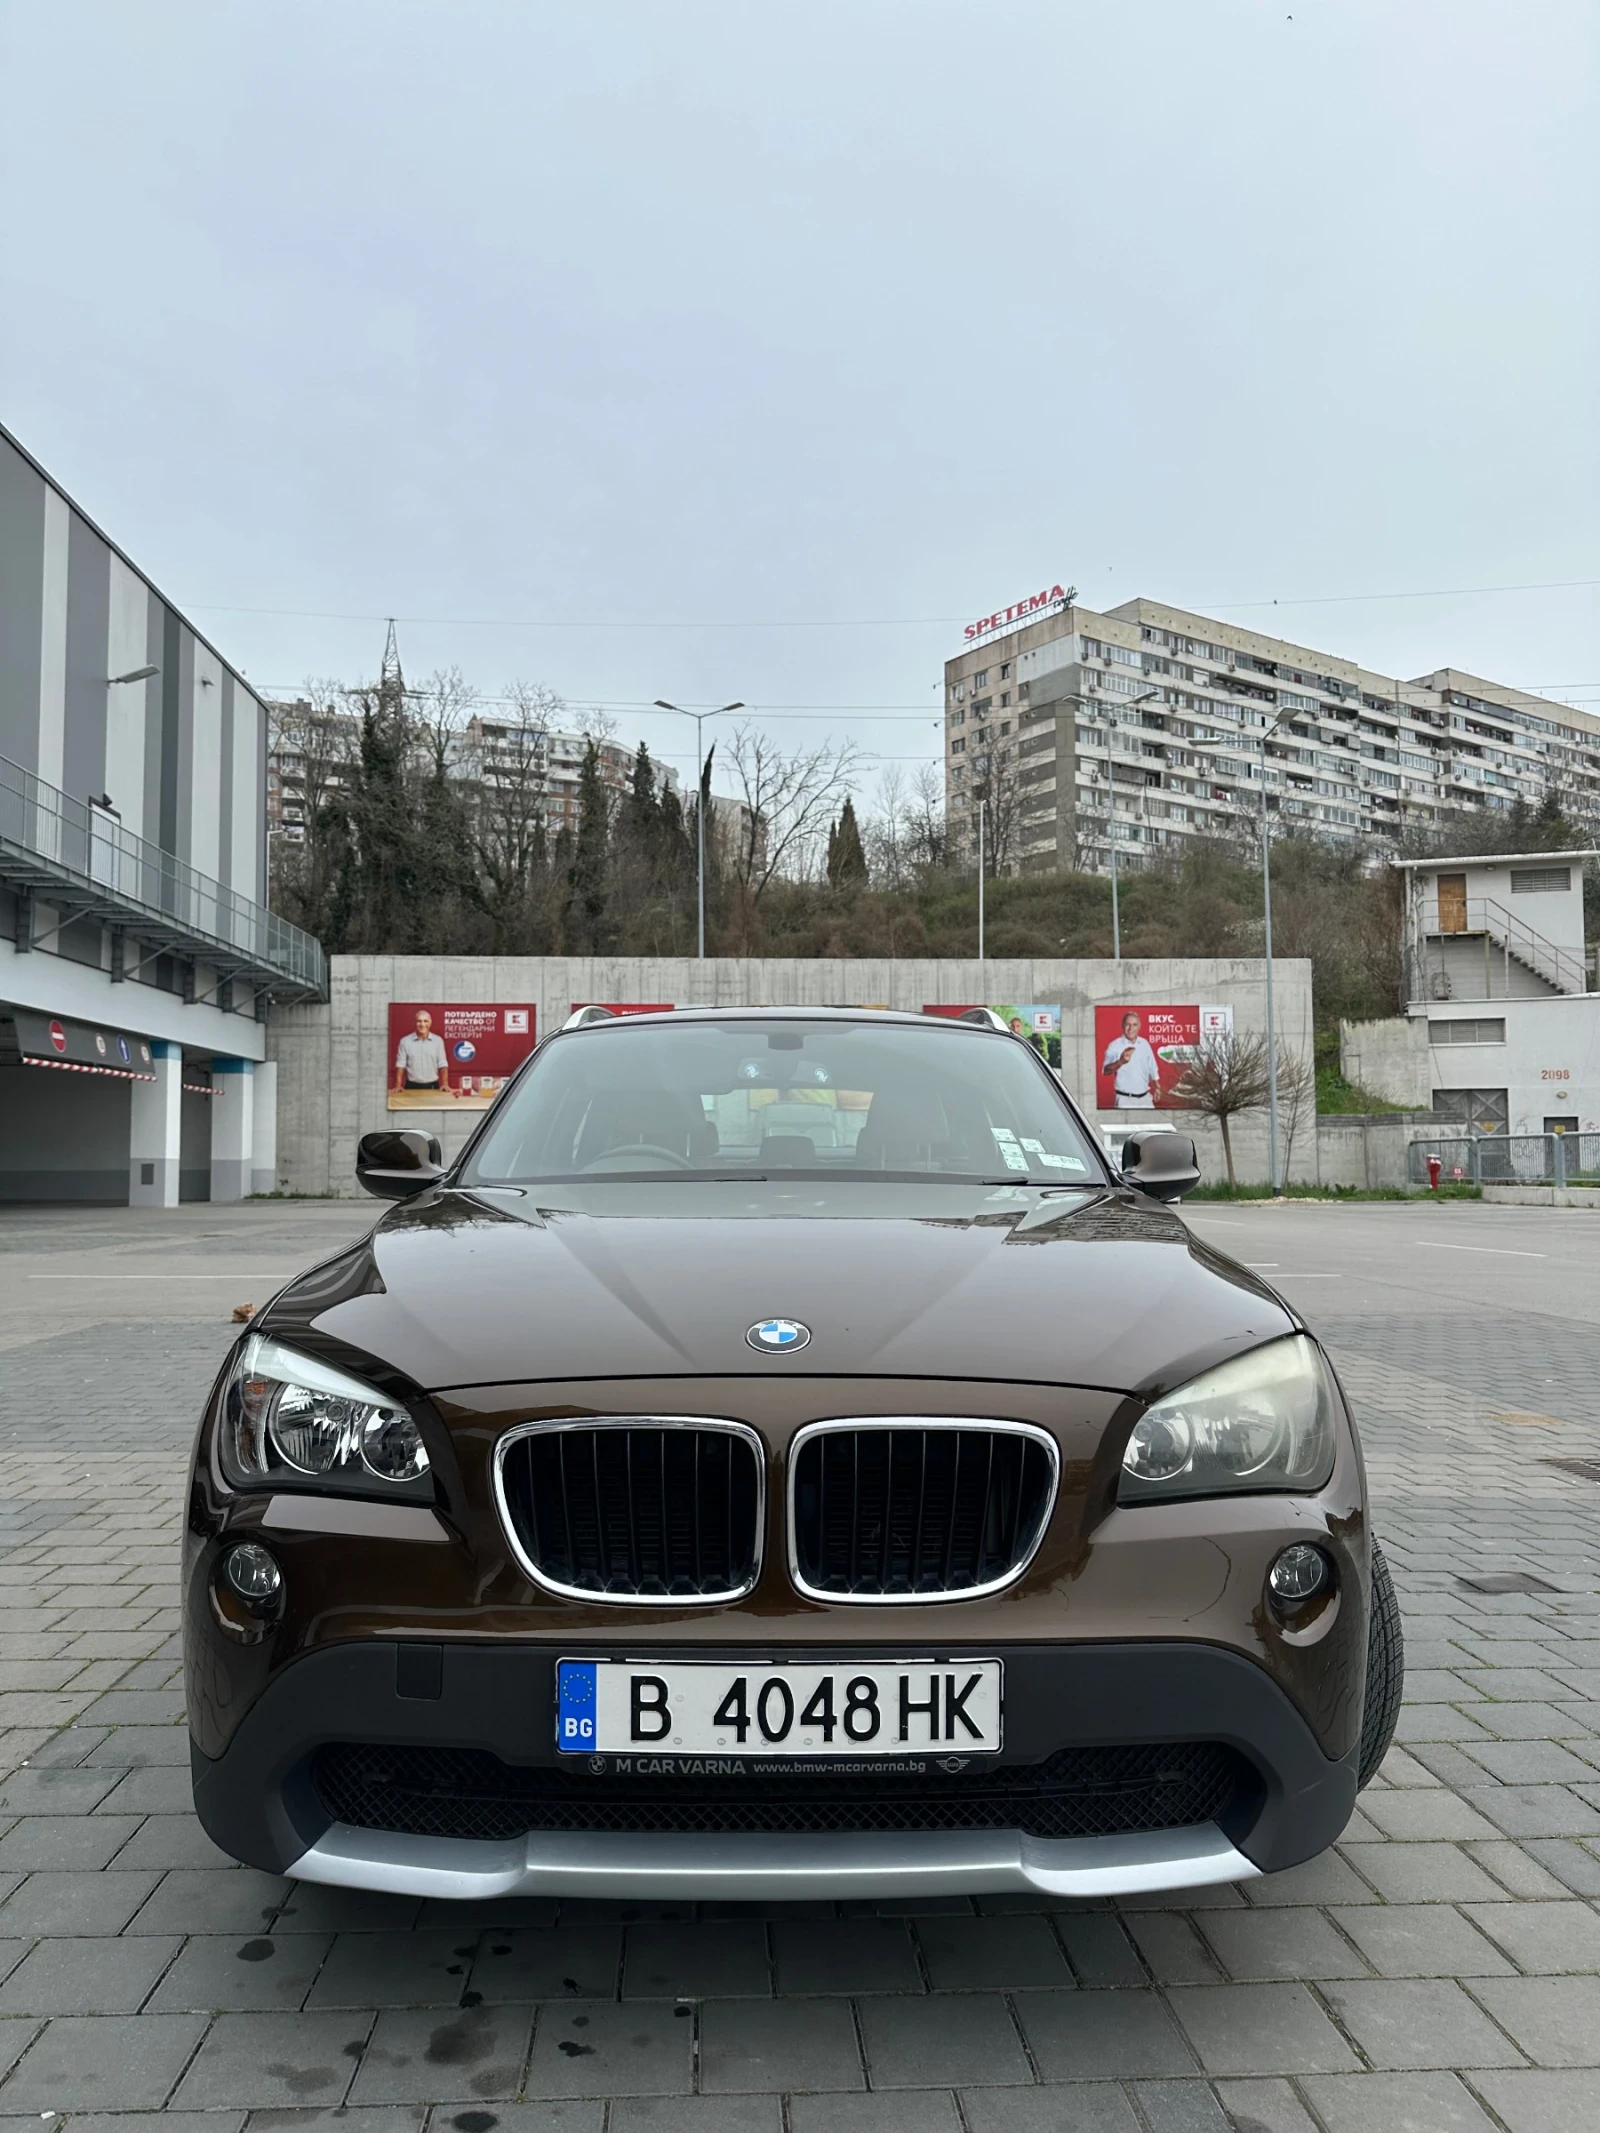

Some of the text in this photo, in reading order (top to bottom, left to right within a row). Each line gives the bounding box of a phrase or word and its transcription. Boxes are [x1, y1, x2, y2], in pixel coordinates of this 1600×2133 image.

[964, 584, 1064, 639] SPETEMA
[1148, 1023, 1197, 1033] КОЙТО ТЕ
[1148, 1034, 1185, 1044] ВРЪЩА
[1541, 1069, 1570, 1080] 2098
[631, 1674, 984, 1742] B 4048 HK
[565, 1717, 593, 1737] BG
[616, 1759, 632, 1773] M
[636, 1759, 675, 1774] CAR
[678, 1759, 747, 1775] VARNA
[753, 1761, 926, 1774] www.bmw-mcarvarna.bg
